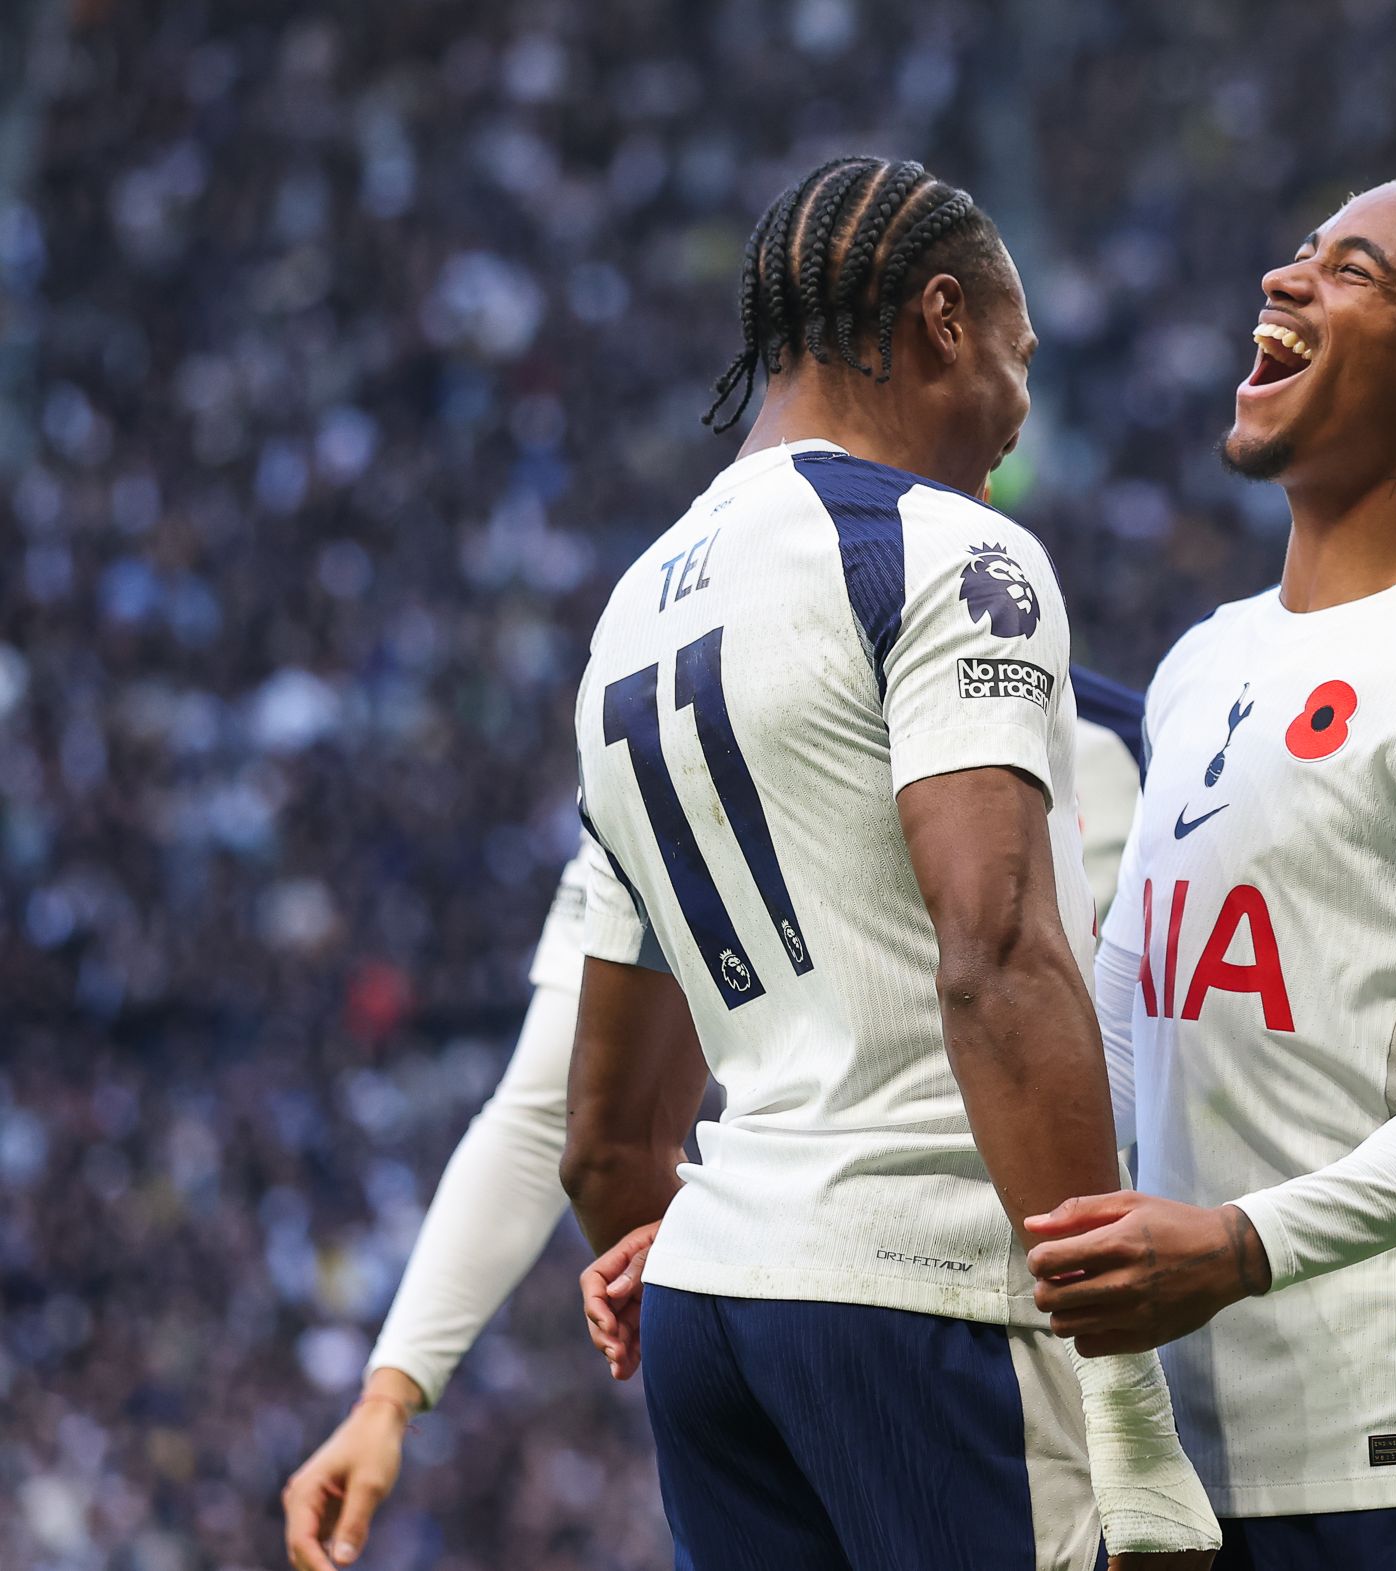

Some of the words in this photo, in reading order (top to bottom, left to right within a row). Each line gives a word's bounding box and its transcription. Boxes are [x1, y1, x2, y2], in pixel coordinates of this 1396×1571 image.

[659, 528, 721, 613] TEL
[957, 659, 994, 681] No
[998, 663, 1048, 693] room
[959, 678, 995, 698] for
[998, 681, 1049, 716] racism
[602, 626, 813, 1010] 11
